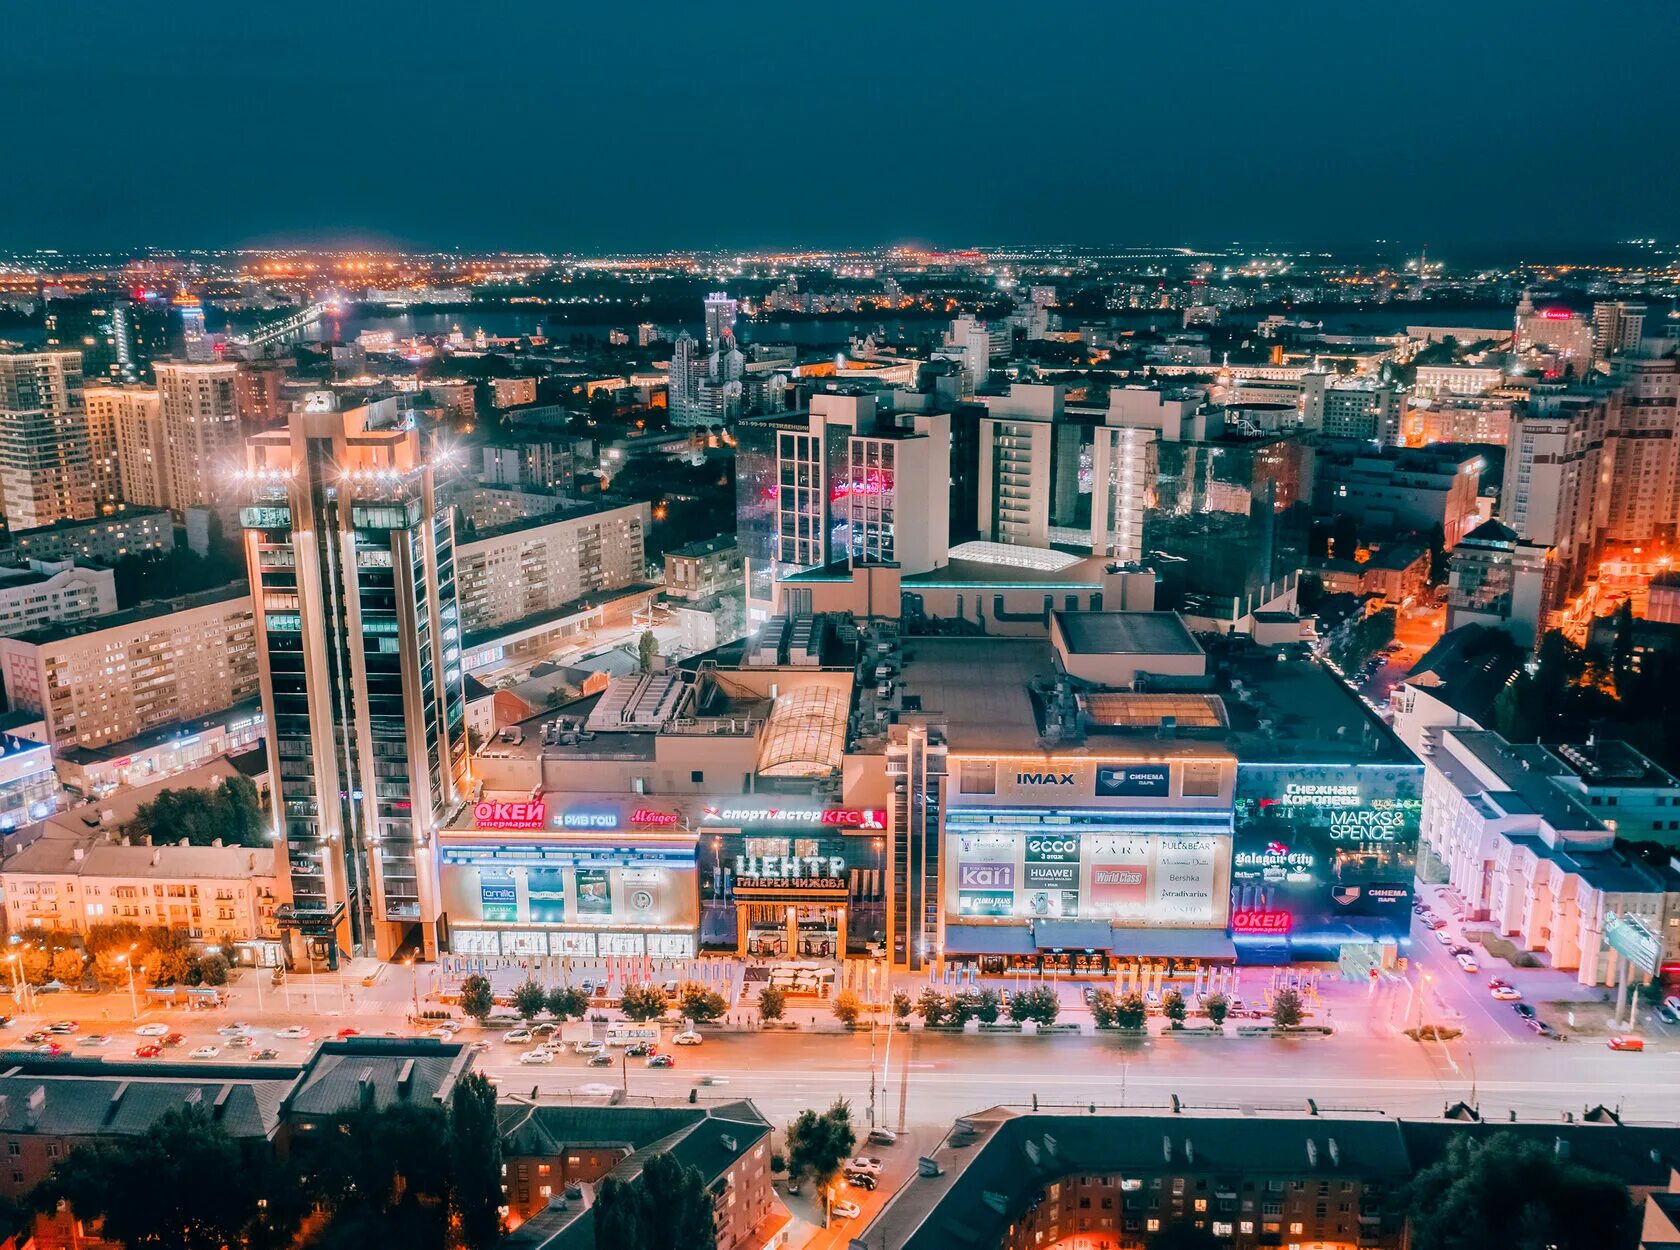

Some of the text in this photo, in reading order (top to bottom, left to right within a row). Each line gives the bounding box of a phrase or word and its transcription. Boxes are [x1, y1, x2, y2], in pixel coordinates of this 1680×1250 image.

[738, 420, 767, 428] 261-99-99
[1016, 773, 1075, 785] IMAX
[1286, 783, 1359, 795] Снежная
[1282, 795, 1361, 807] Королева
[564, 815, 617, 827] РИВ ГОШ
[821, 811, 859, 823] KFC
[476, 821, 543, 829] гипермаркет
[1029, 838, 1077, 853] ecco
[1162, 842, 1211, 850] PULL&BEAR
[1040, 852, 1046, 860] 3
[1287, 852, 1314, 867] City
[736, 855, 845, 878] ЦЕНТР
[962, 866, 1011, 885] kari
[1030, 868, 1073, 878] HUAWEI
[1096, 872, 1142, 884] World Class
[1169, 874, 1200, 882] Bershka
[792, 878, 845, 889] ЧИЖОВА
[1368, 889, 1408, 897] СИНЕМА
